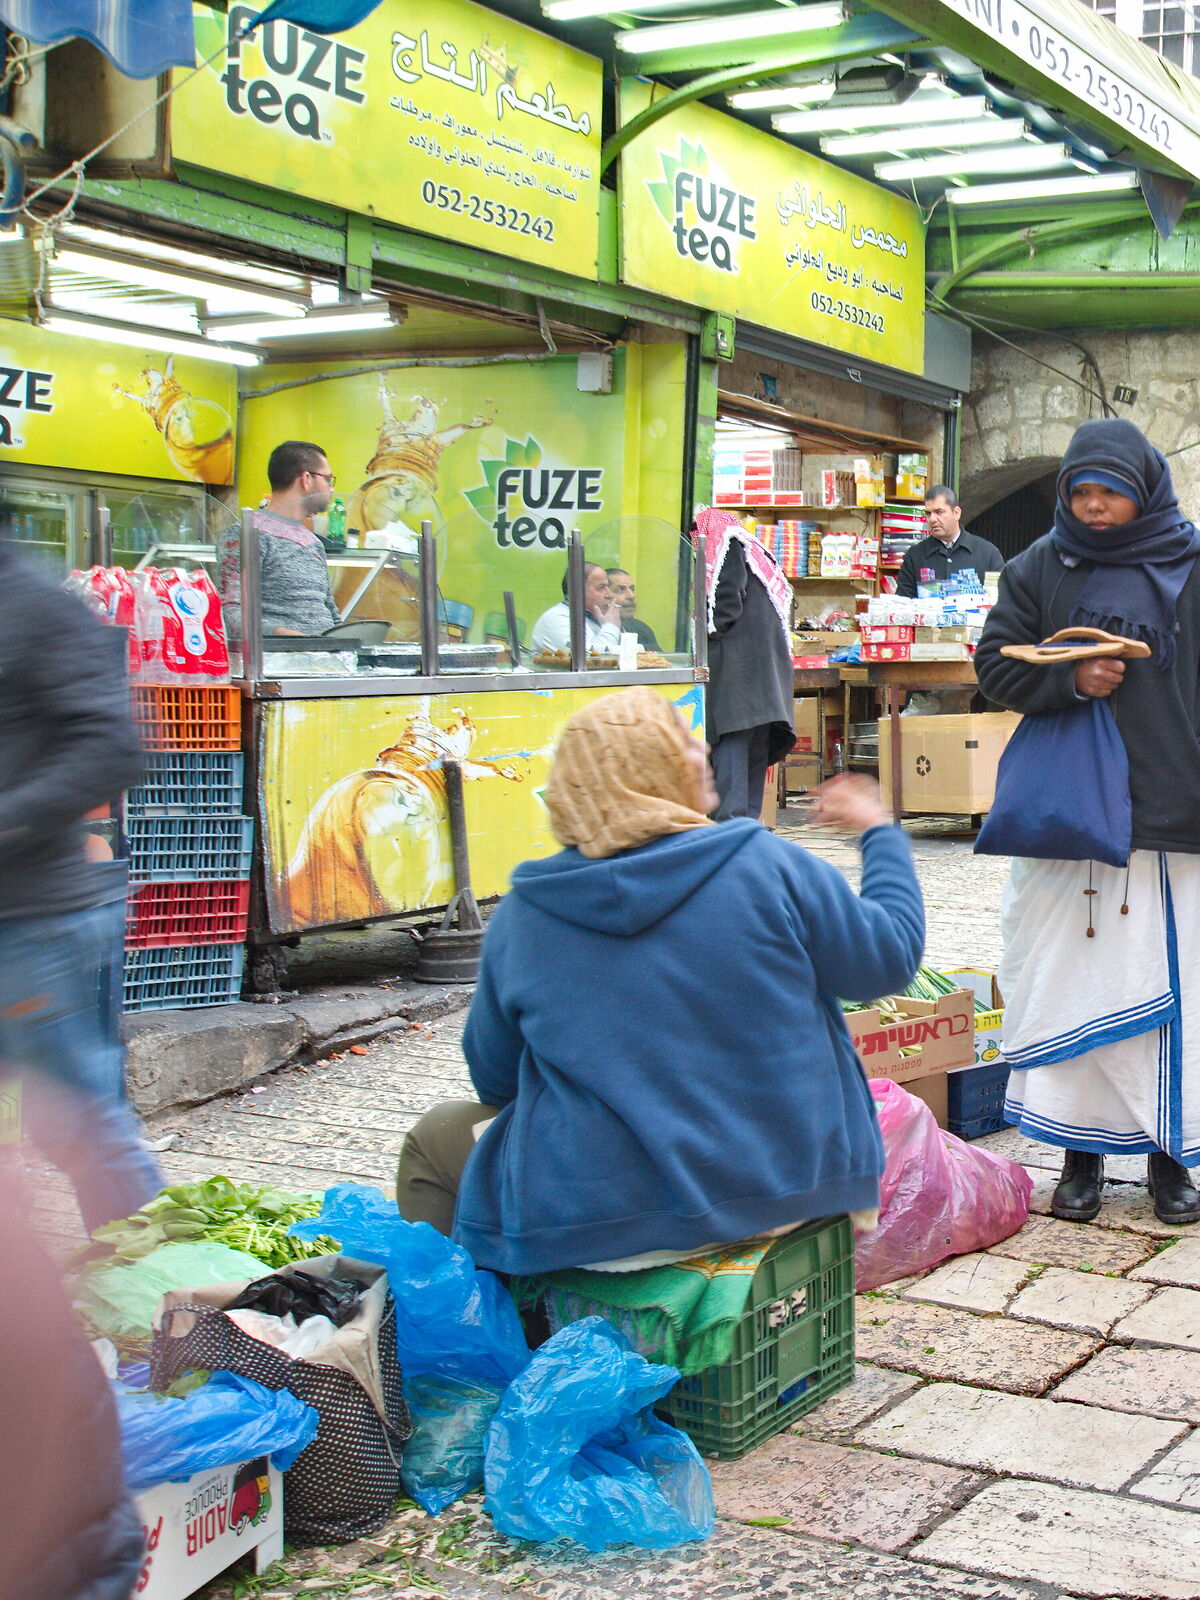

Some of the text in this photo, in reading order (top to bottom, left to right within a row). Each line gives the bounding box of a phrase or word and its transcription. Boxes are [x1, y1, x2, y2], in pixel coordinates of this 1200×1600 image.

[227, 5, 365, 104] FUZE
[391, 29, 592, 136] مطعم التاج
[220, 64, 321, 141] tea
[1029, 25, 1172, 151] 052-2532242
[422, 181, 555, 242] 052-2532242
[675, 172, 756, 240] FUZE
[776, 182, 908, 259] محمص الحلواني
[672, 217, 732, 272] tea
[811, 292, 885, 333] 052-2532242
[497, 469, 603, 510] FUZE
[492, 511, 566, 549] tea
[185, 1476, 229, 1521] PRODUCE
[186, 1498, 229, 1556] ADIR
